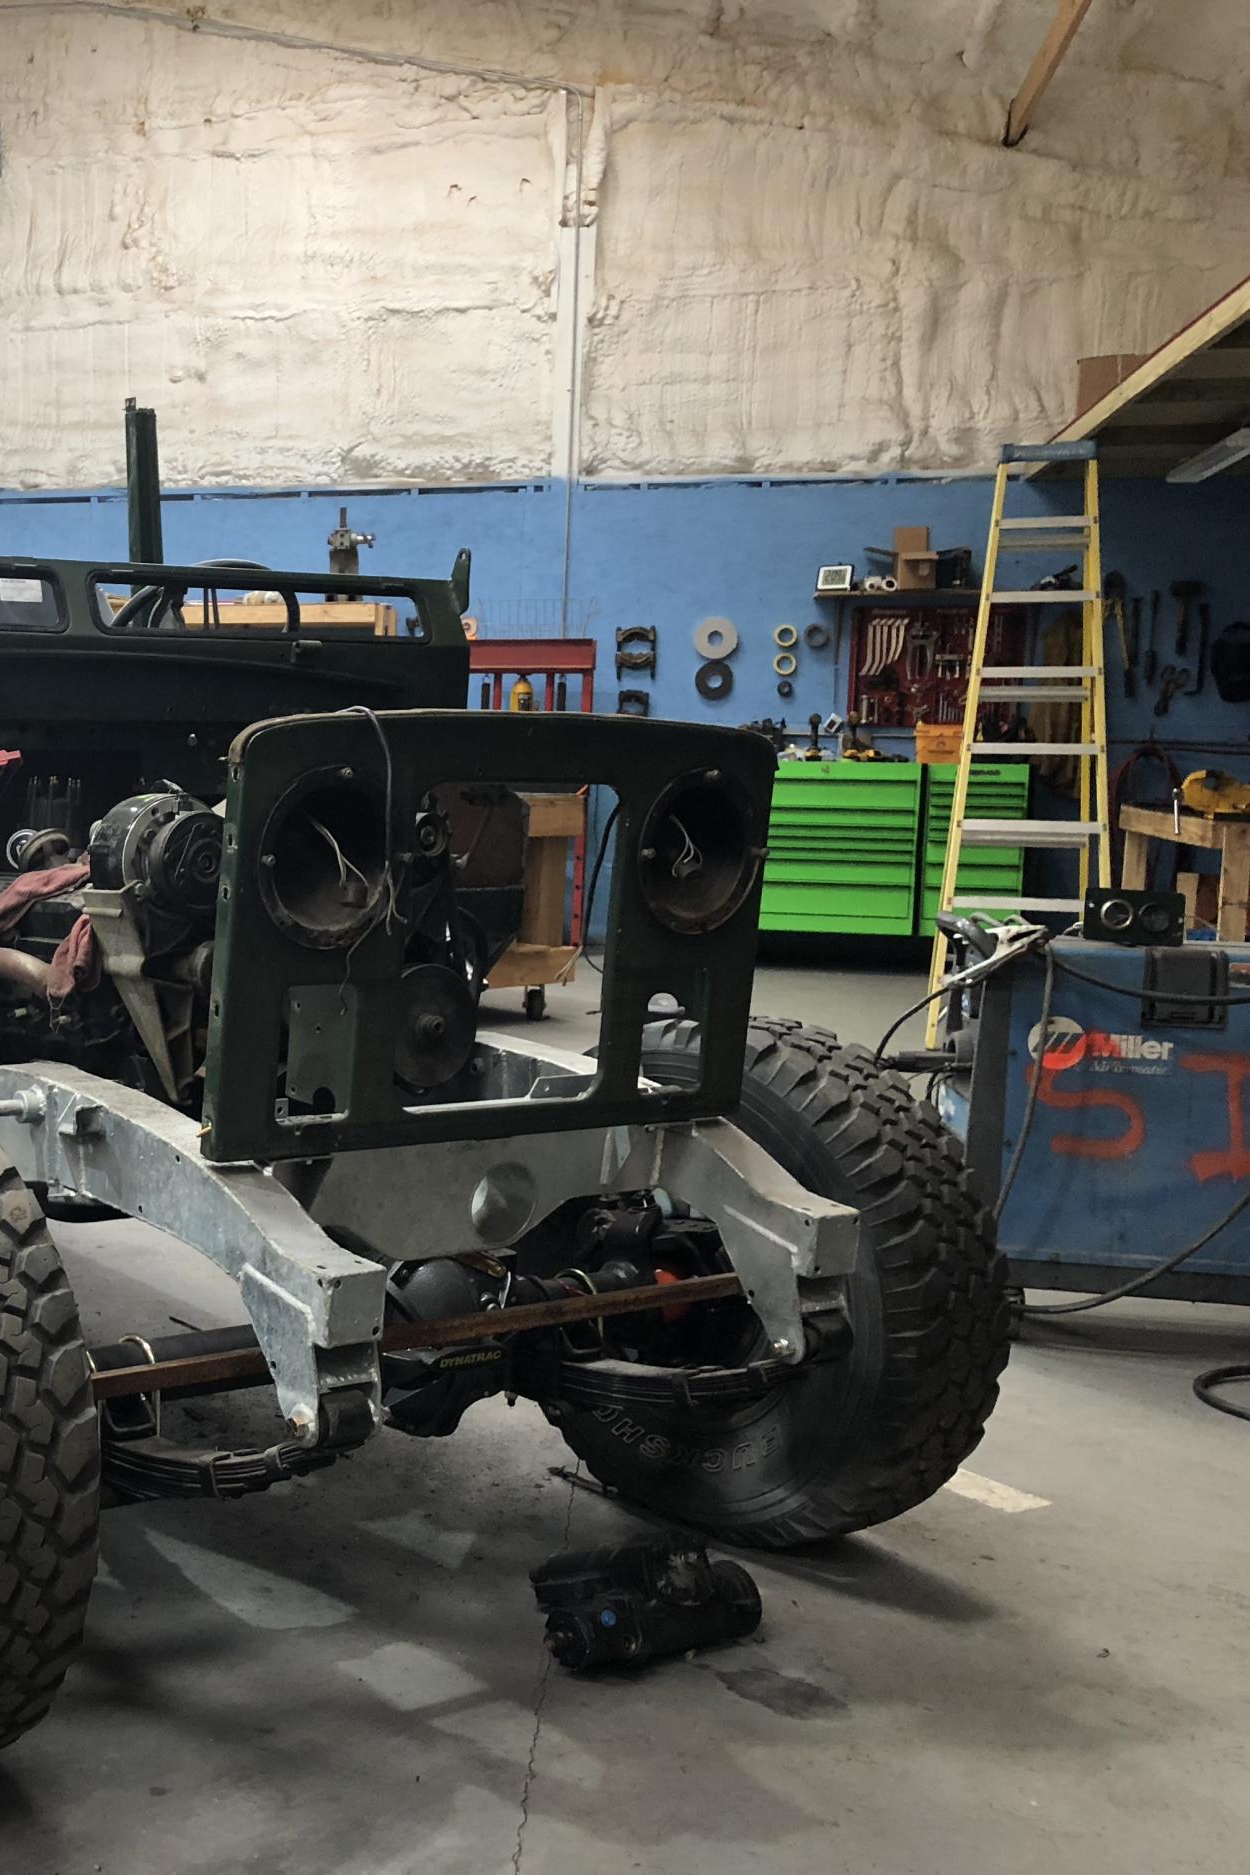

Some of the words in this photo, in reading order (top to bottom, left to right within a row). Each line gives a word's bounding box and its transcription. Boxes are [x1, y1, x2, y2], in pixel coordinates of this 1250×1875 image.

[1090, 1033, 1174, 1060] Miller
[439, 1350, 502, 1368] DYNATRAC
[592, 1405, 783, 1473] BUCKSHO
